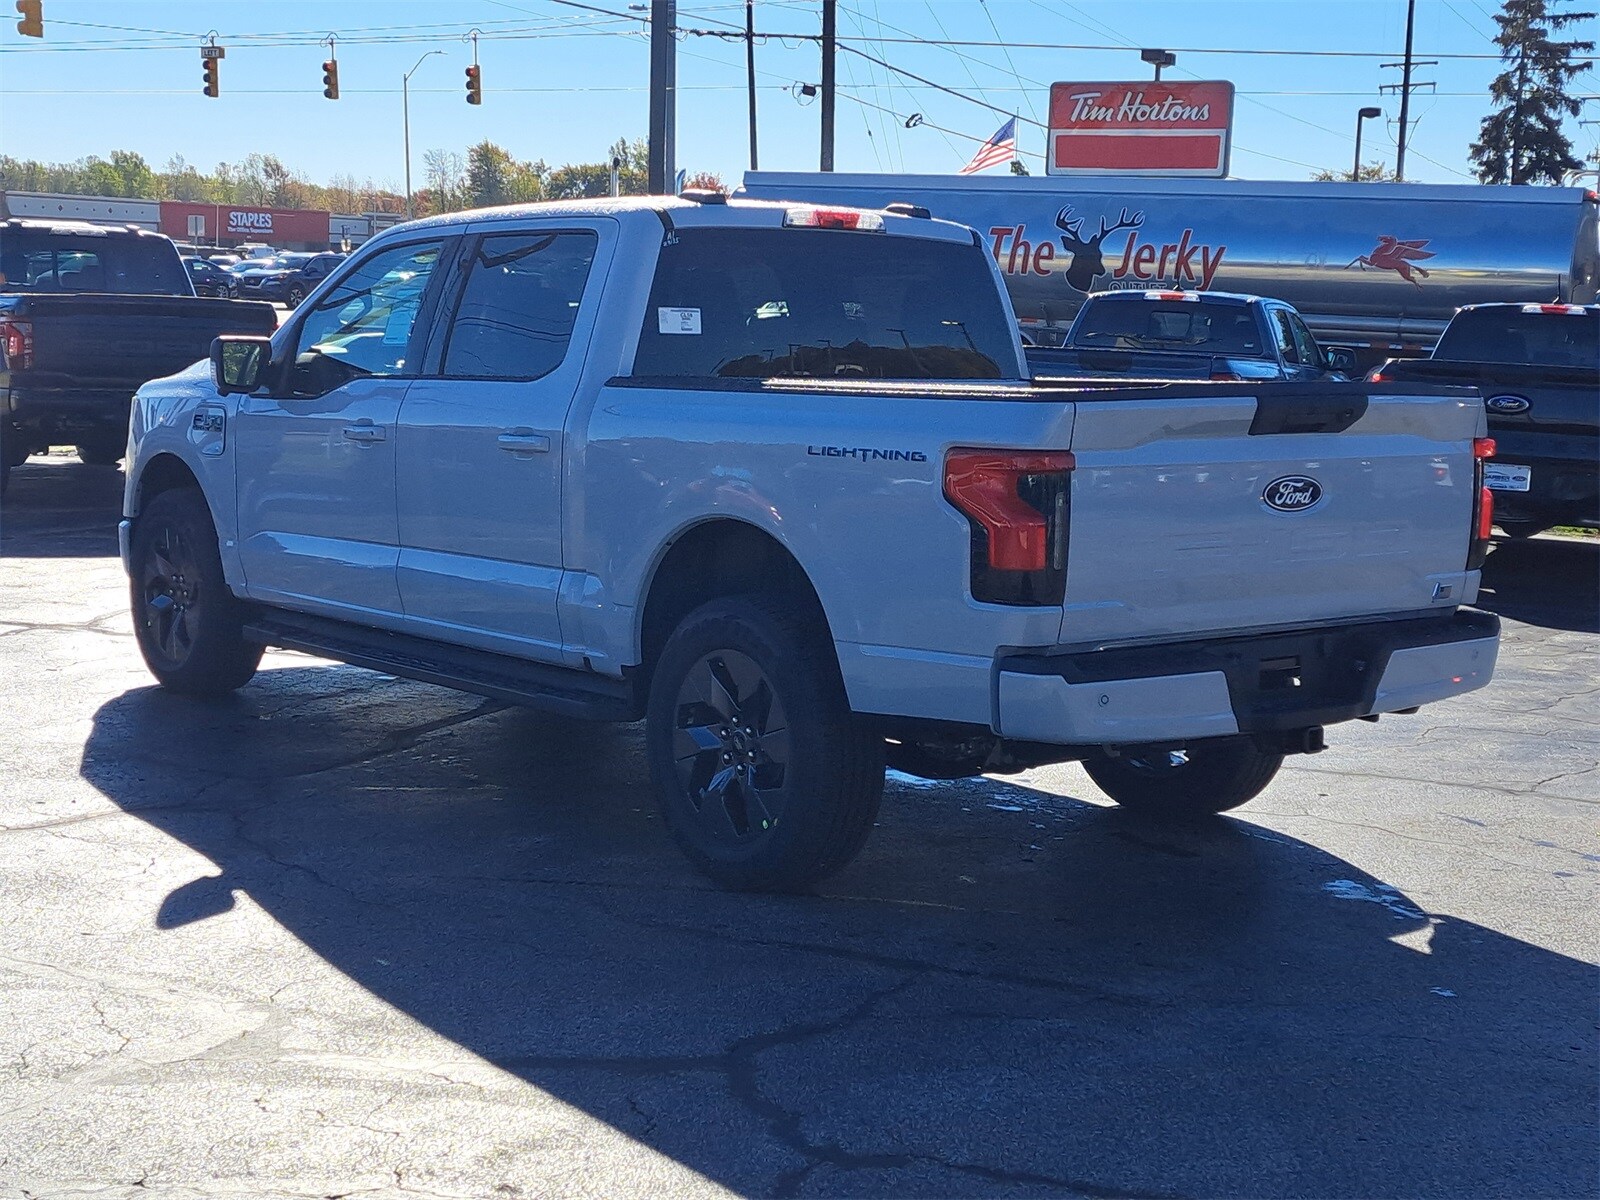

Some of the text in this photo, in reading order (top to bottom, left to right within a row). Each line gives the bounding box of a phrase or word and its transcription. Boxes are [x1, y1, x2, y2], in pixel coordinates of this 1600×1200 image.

[203, 49, 219, 57] LEFT
[1070, 91, 1210, 122] Tim Hortons
[229, 211, 272, 227] STAPLES
[989, 224, 1227, 292] The Jerky
[1497, 399, 1520, 409] Ford
[807, 445, 927, 462] LIGHTNING
[1275, 481, 1313, 505] Ford
